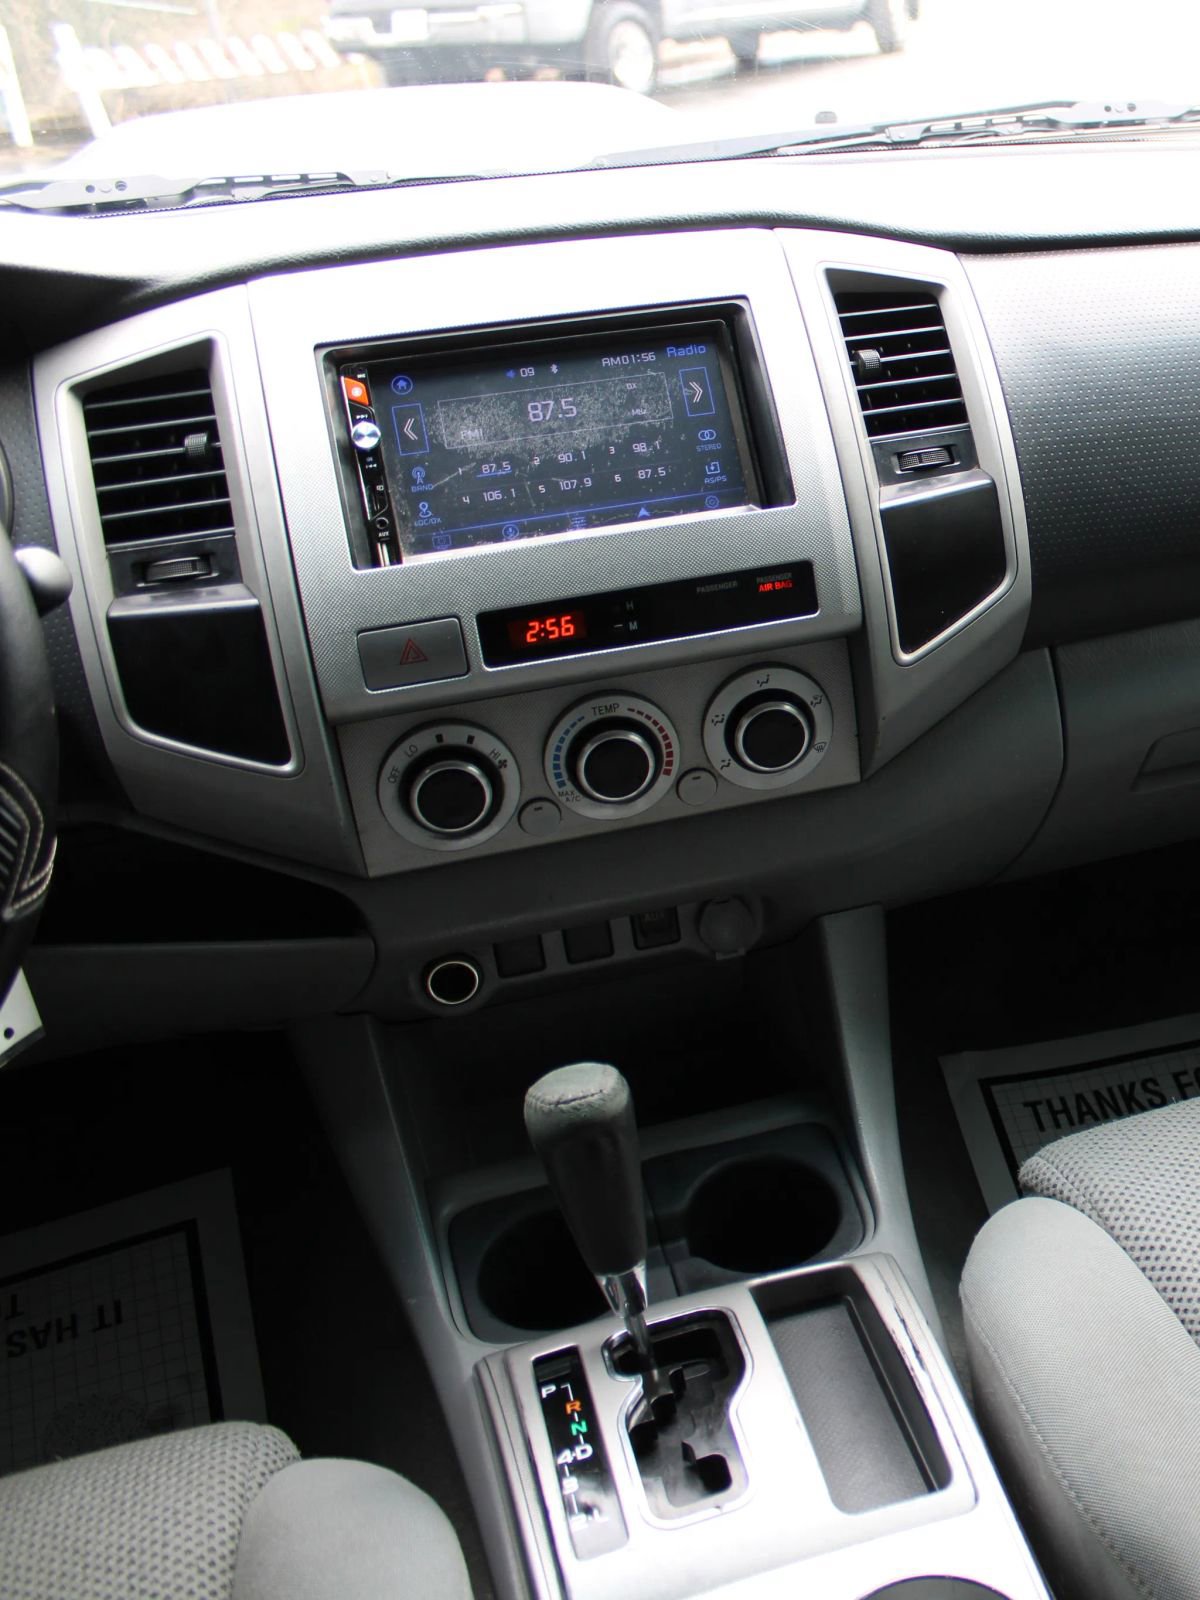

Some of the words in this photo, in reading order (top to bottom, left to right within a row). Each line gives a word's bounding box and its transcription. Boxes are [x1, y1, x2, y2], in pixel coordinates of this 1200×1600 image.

[666, 344, 708, 358] Radio
[601, 352, 657, 368] AM01:56
[519, 367, 535, 378] 09
[527, 397, 577, 422] 87.5
[608, 446, 615, 454] 3
[632, 440, 660, 454] 98.1
[532, 456, 540, 465] 2
[558, 451, 586, 464] 90.1
[481, 461, 511, 474] 87.5
[614, 474, 622, 482] 6
[638, 466, 666, 480] 87.5
[538, 485, 546, 493] 5
[559, 477, 593, 491] 107.9
[462, 496, 471, 505] 4
[483, 488, 516, 502] 106.1
[696, 580, 738, 593] PASSENGER
[758, 582, 774, 593] AIR
[774, 579, 793, 590] BAG
[525, 615, 575, 643] 2:56
[628, 620, 638, 631] M
[591, 703, 620, 716] TEMP
[404, 744, 418, 759] LO
[489, 747, 502, 760] HI
[387, 766, 400, 784] OFF
[1022, 1077, 1169, 1133] THANKS
[91, 1298, 124, 1333] IT
[5, 1313, 79, 1359] HAS
[541, 1385, 557, 1399] P
[565, 1400, 583, 1415] R
[571, 1420, 588, 1436] N
